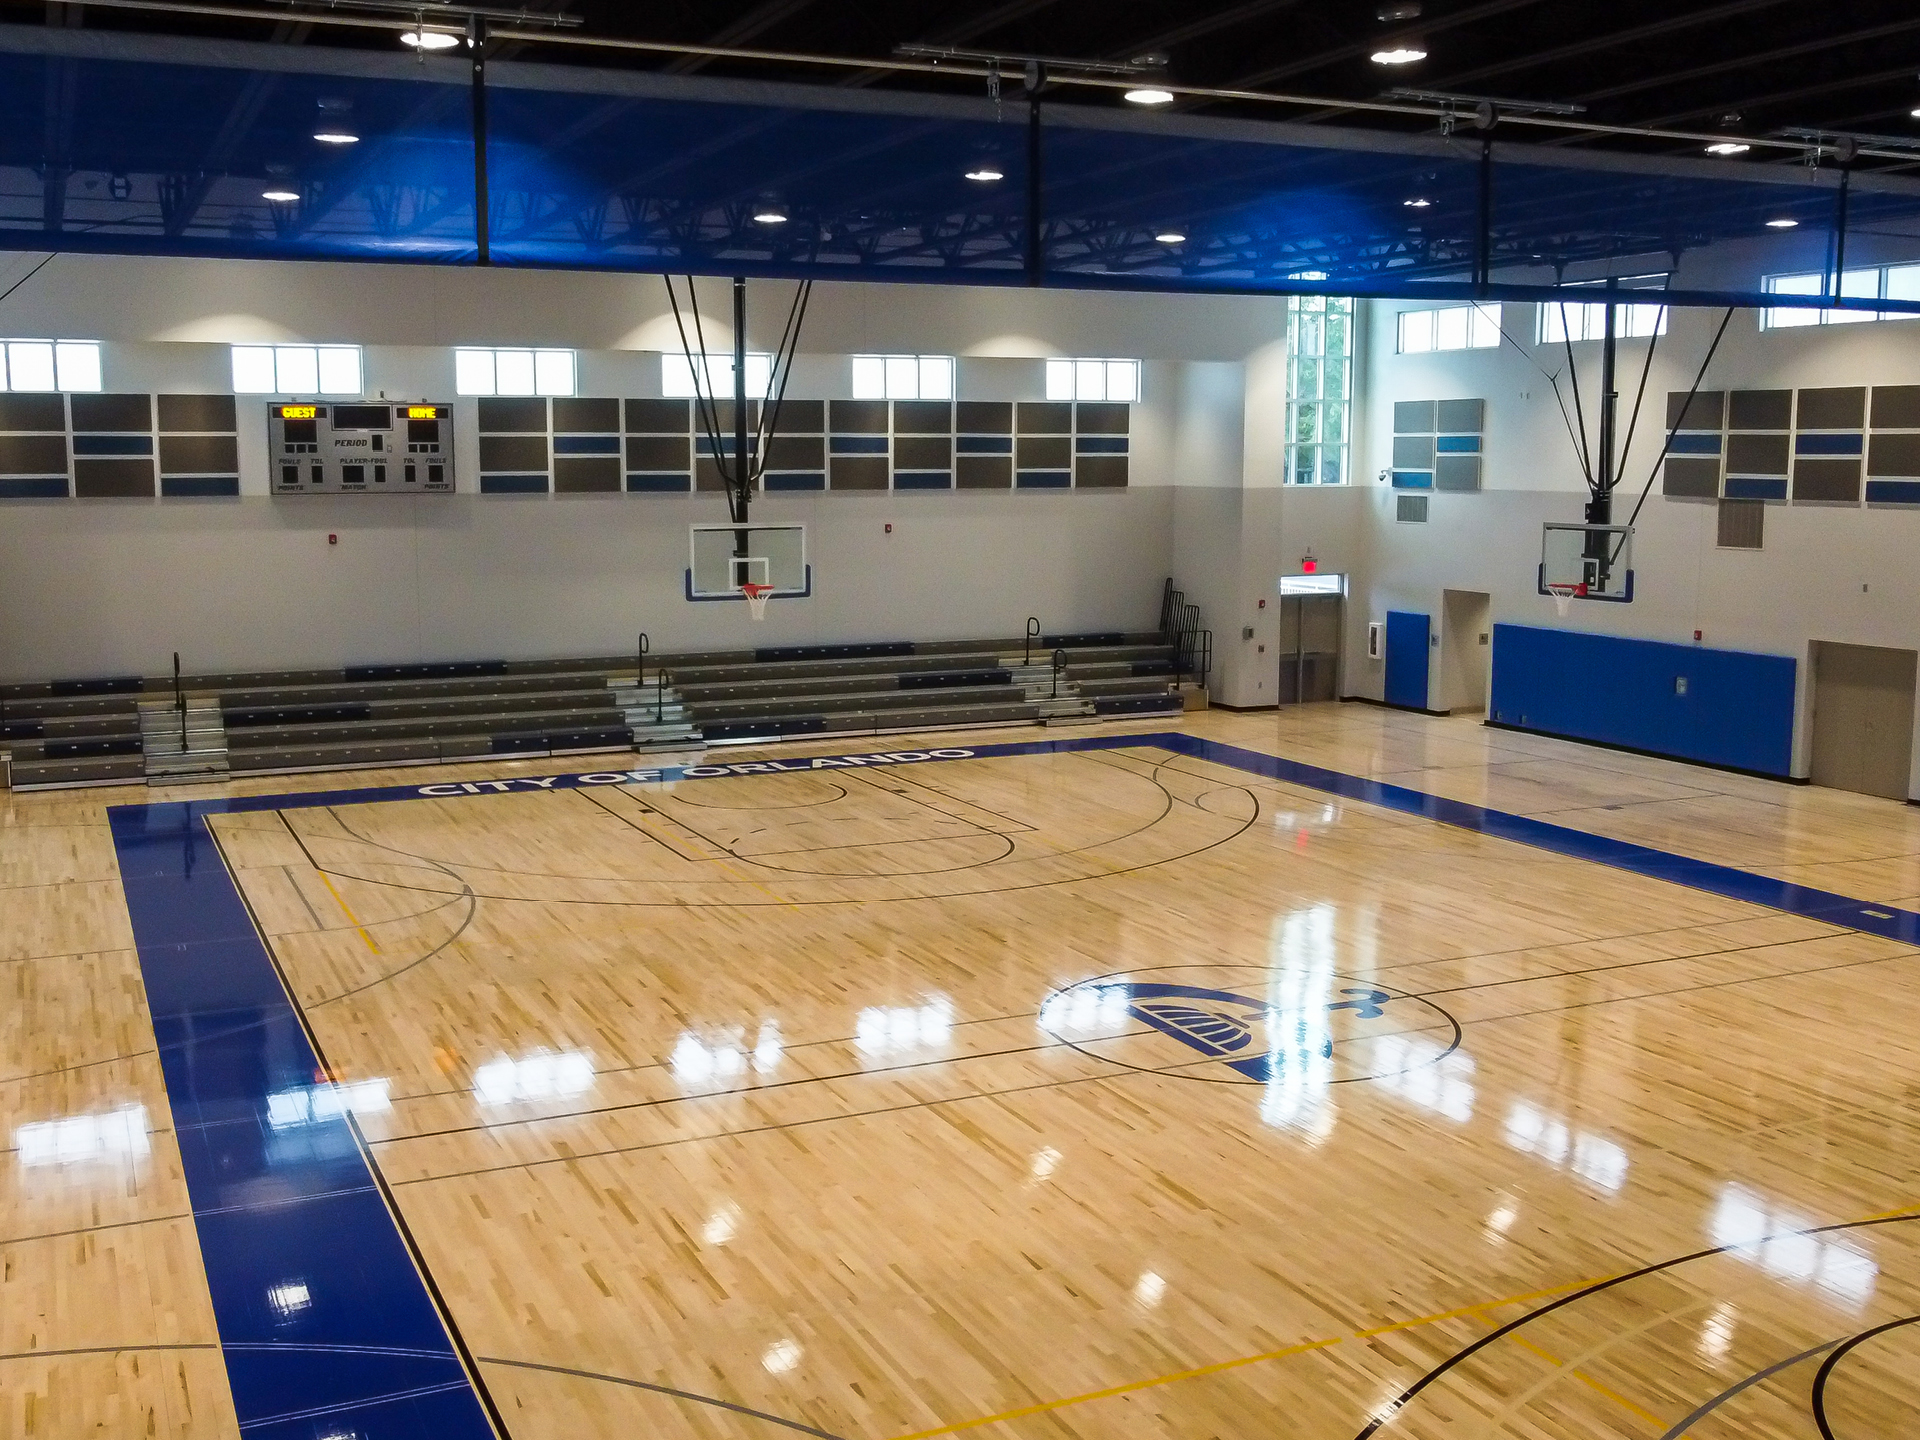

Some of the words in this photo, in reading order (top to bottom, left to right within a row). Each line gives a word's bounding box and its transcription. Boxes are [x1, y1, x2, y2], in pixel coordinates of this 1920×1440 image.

[281, 406, 316, 418] GUEST
[408, 406, 436, 419] HOME
[334, 439, 368, 447] PERIOD
[418, 776, 557, 797] CITY
[577, 769, 663, 785] OF
[682, 749, 975, 777] ORLANDO
